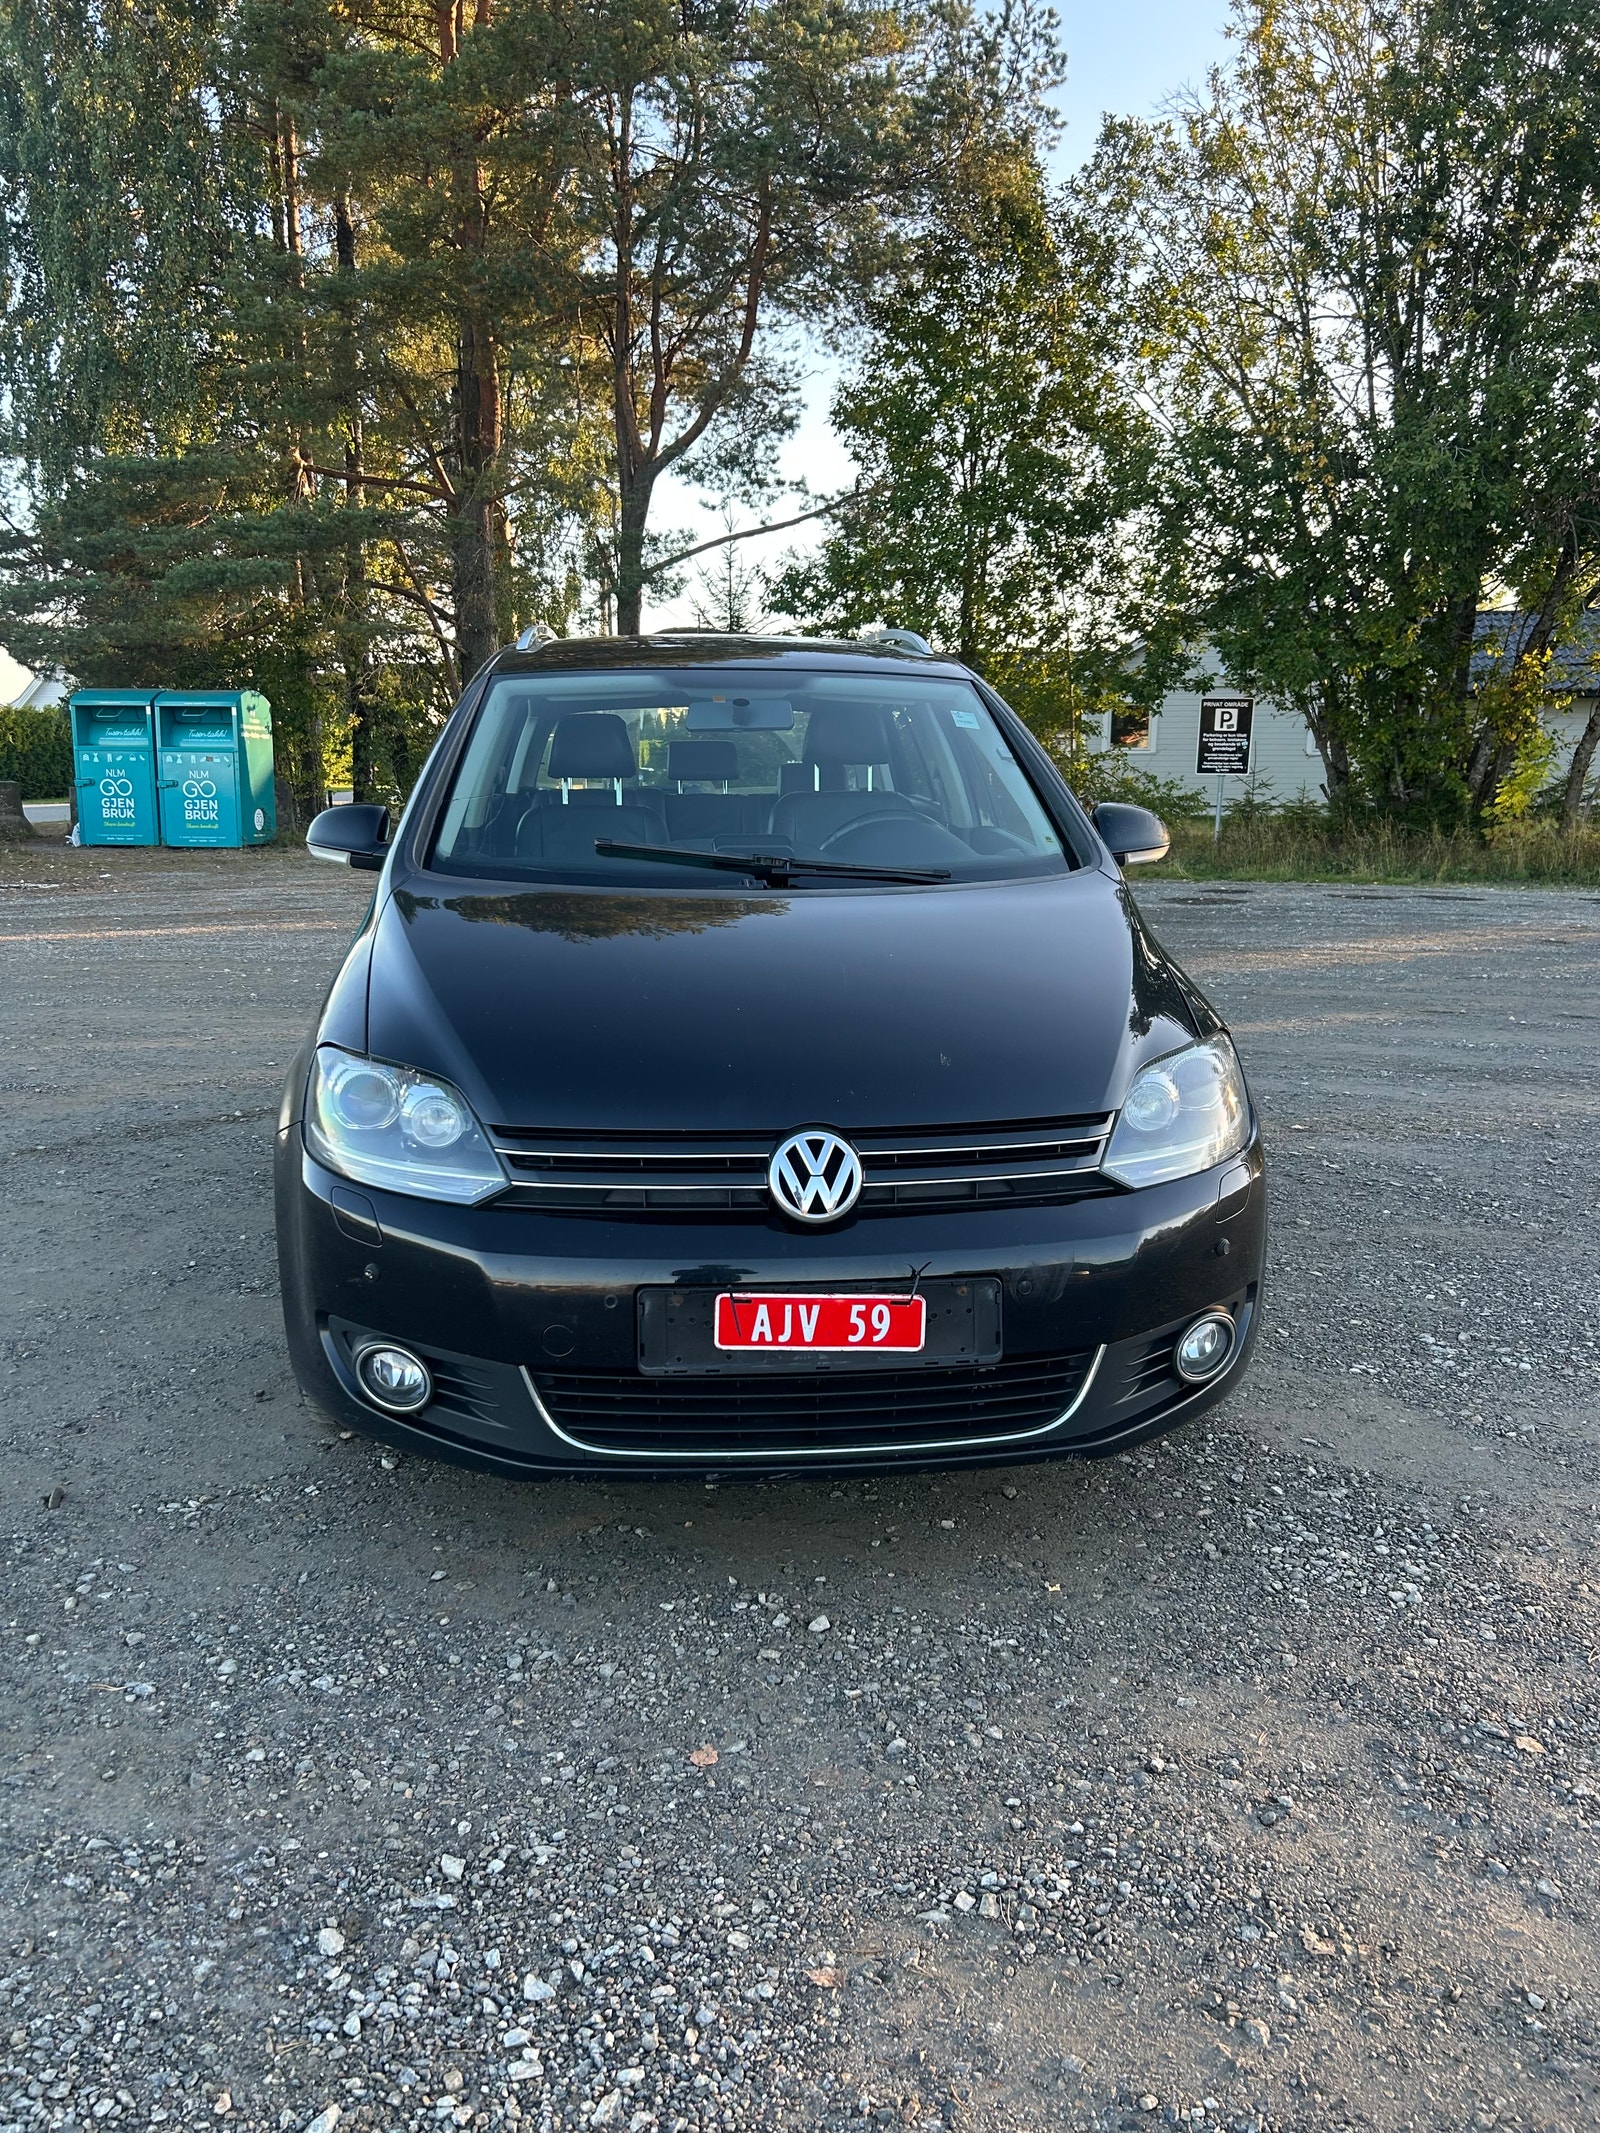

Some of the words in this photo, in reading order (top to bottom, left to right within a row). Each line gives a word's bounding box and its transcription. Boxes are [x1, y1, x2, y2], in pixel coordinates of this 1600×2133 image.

[1220, 711, 1233, 729] P
[105, 769, 126, 778] NLM
[189, 770, 209, 779] NLM
[100, 778, 133, 796] GO
[183, 780, 216, 798] GO
[101, 798, 135, 808] GJEN
[184, 800, 218, 810] GJEN
[102, 808, 136, 819] BRUK
[185, 810, 219, 820] BRUK
[750, 1303, 821, 1343] AJV
[847, 1303, 892, 1343] 59
